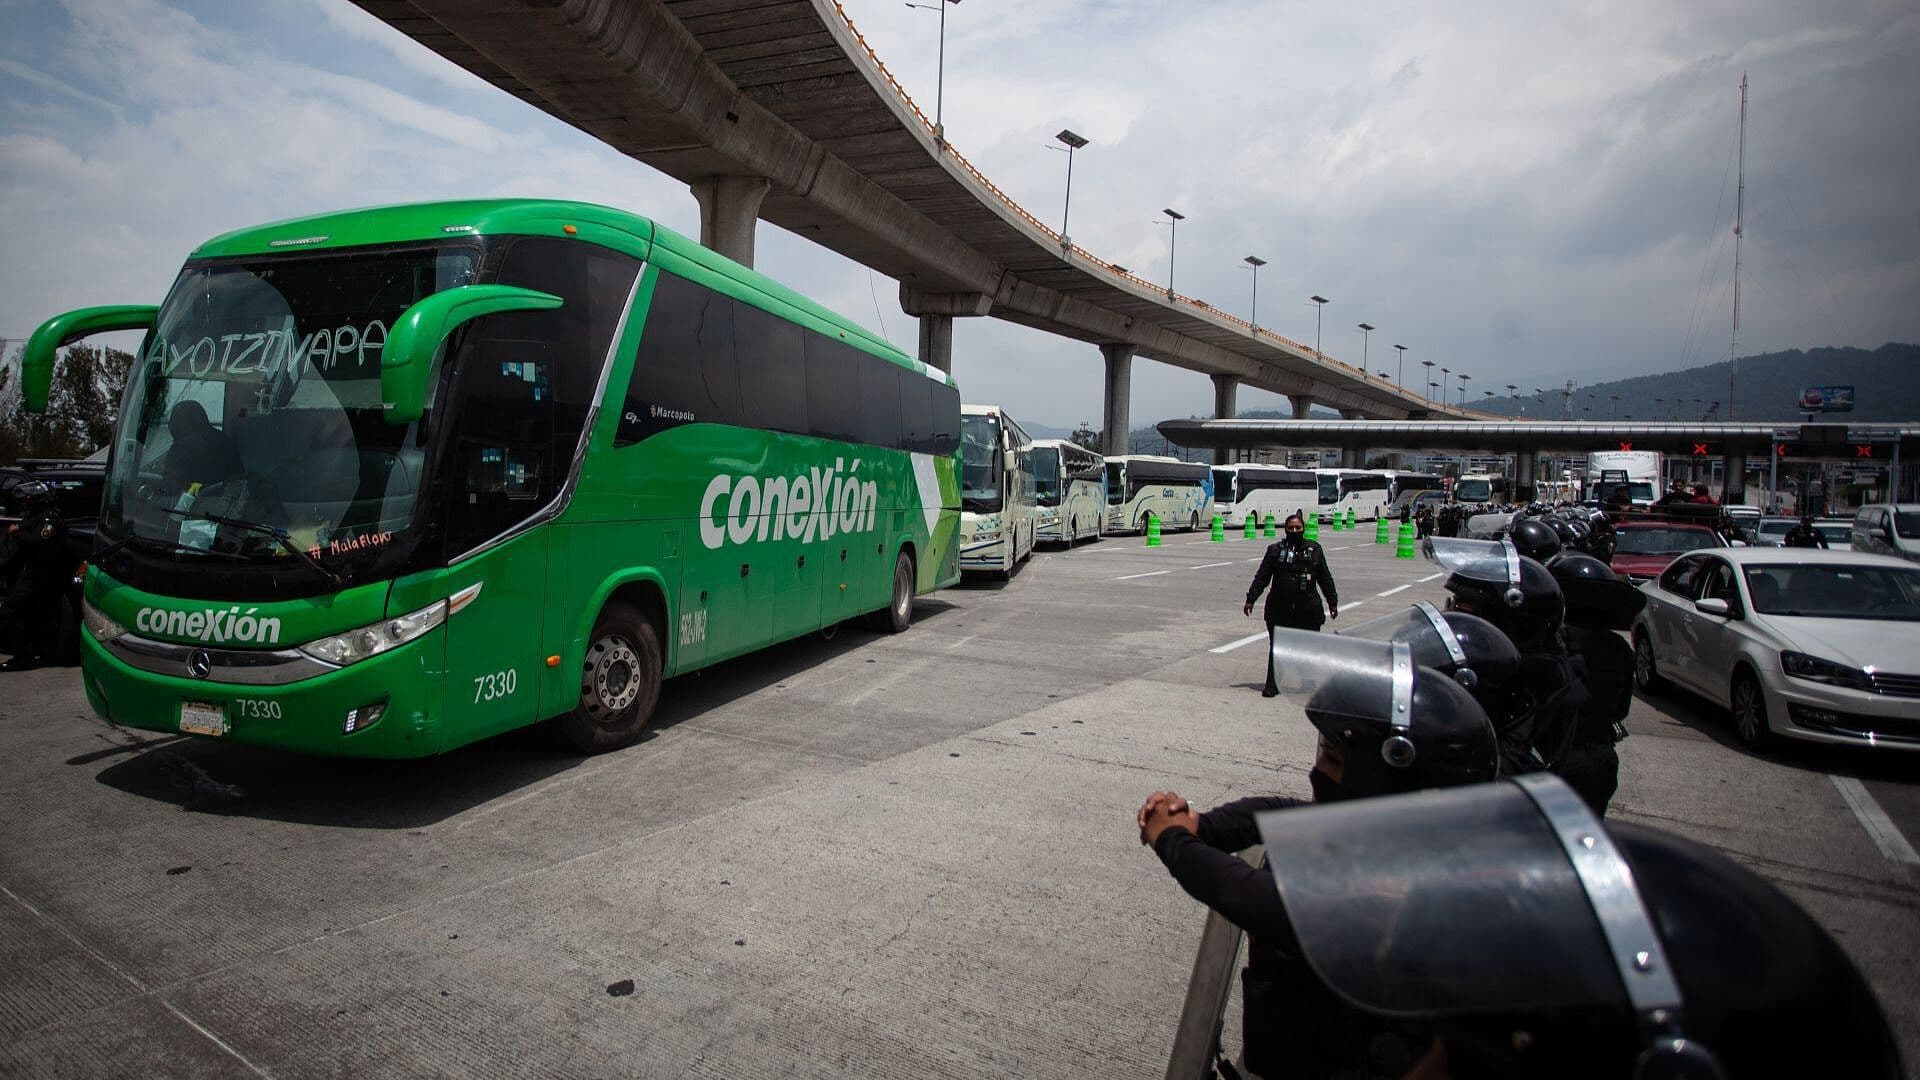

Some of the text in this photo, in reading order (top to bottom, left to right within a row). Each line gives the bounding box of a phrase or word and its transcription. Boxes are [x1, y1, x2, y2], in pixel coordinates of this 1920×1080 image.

[656, 406, 695, 421] Marcopolo
[474, 668, 517, 704] 7330
[236, 699, 282, 719] 7330
